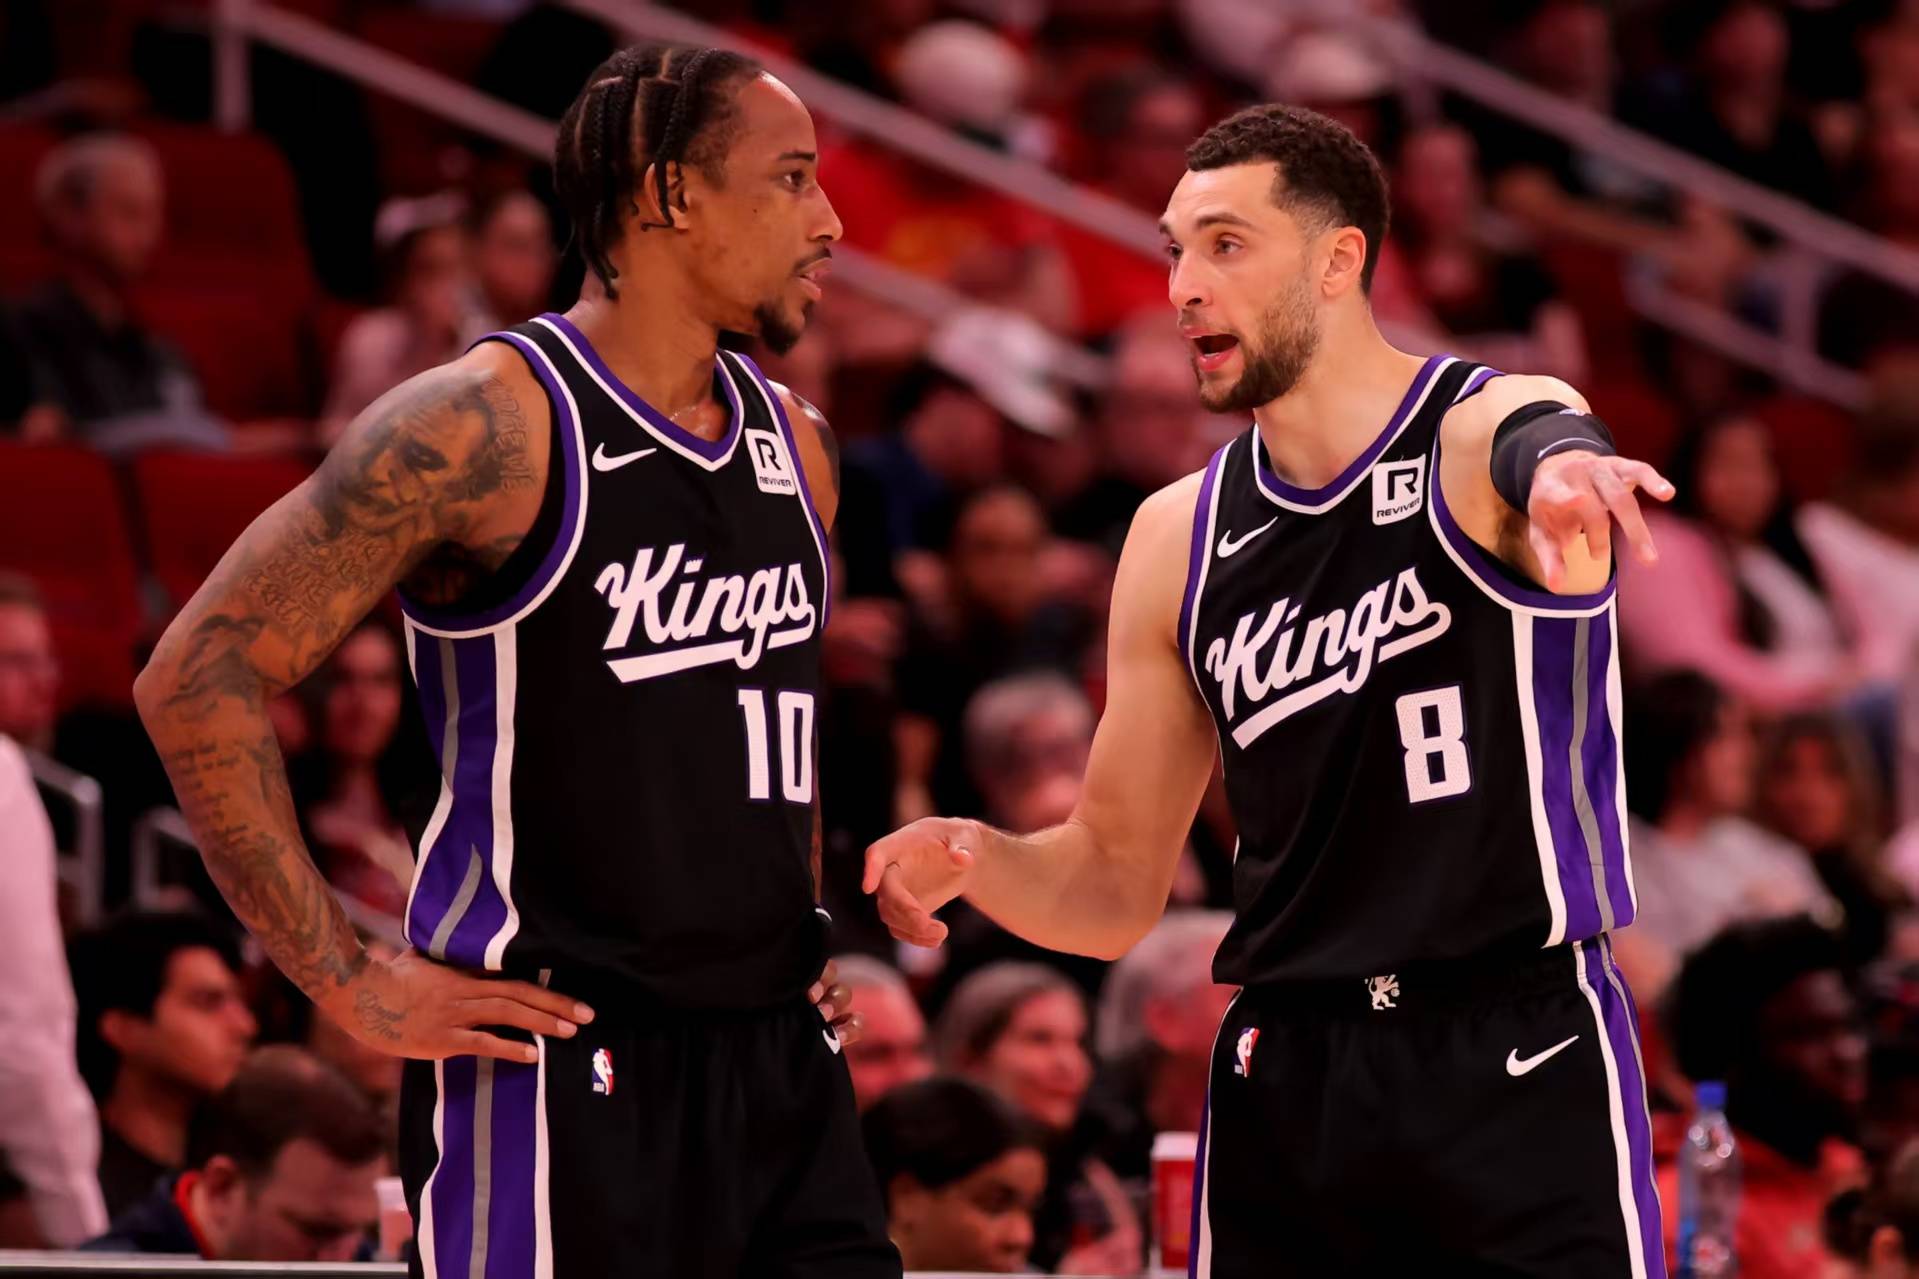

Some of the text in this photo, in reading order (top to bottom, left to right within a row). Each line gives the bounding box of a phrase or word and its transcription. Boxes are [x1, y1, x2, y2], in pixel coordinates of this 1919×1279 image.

[754, 437, 782, 471] R
[759, 476, 792, 488] REVIVER
[1387, 466, 1419, 501] R
[1376, 497, 1420, 518] REVIVER
[594, 543, 816, 684] Kings
[1204, 566, 1452, 750] Kings
[738, 688, 815, 804] 10
[1394, 685, 1471, 803] 8
